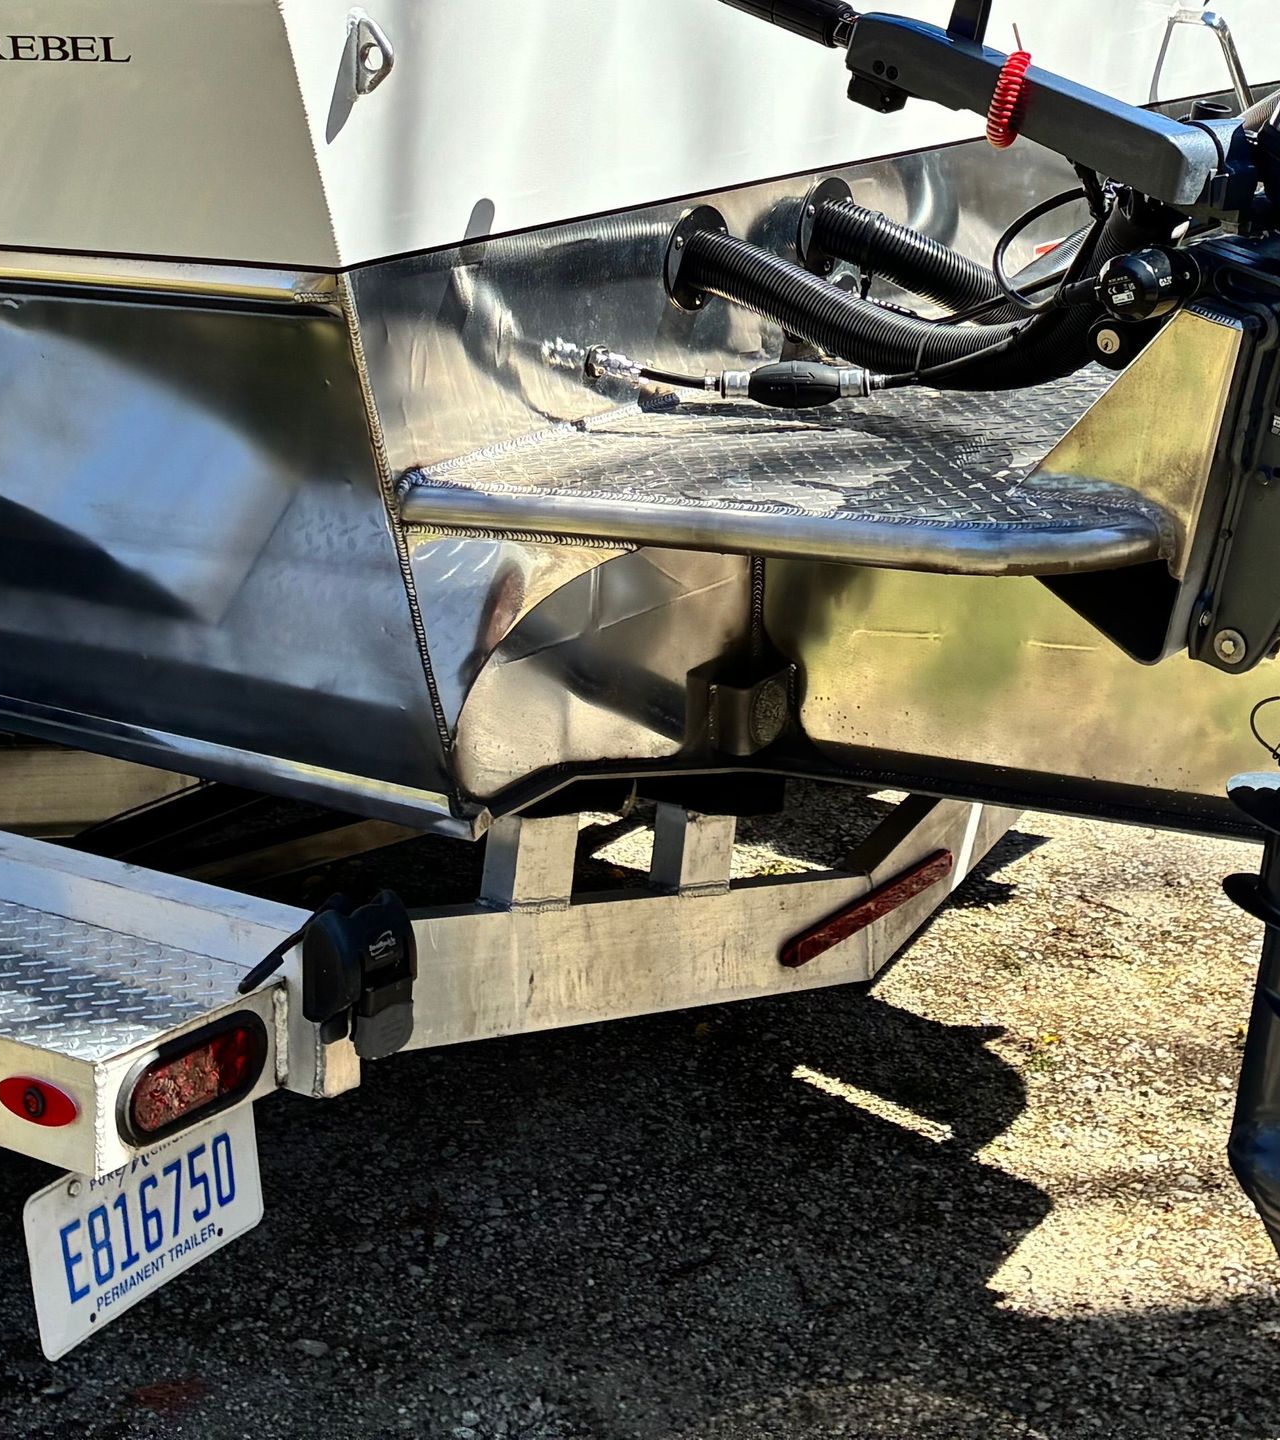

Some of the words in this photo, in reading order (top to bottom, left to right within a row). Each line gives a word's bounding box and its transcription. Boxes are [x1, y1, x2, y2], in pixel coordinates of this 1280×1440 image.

[59, 1132, 236, 1304] E816750
[96, 1254, 167, 1312] PERMANENT
[168, 1222, 217, 1262] TRAILER
